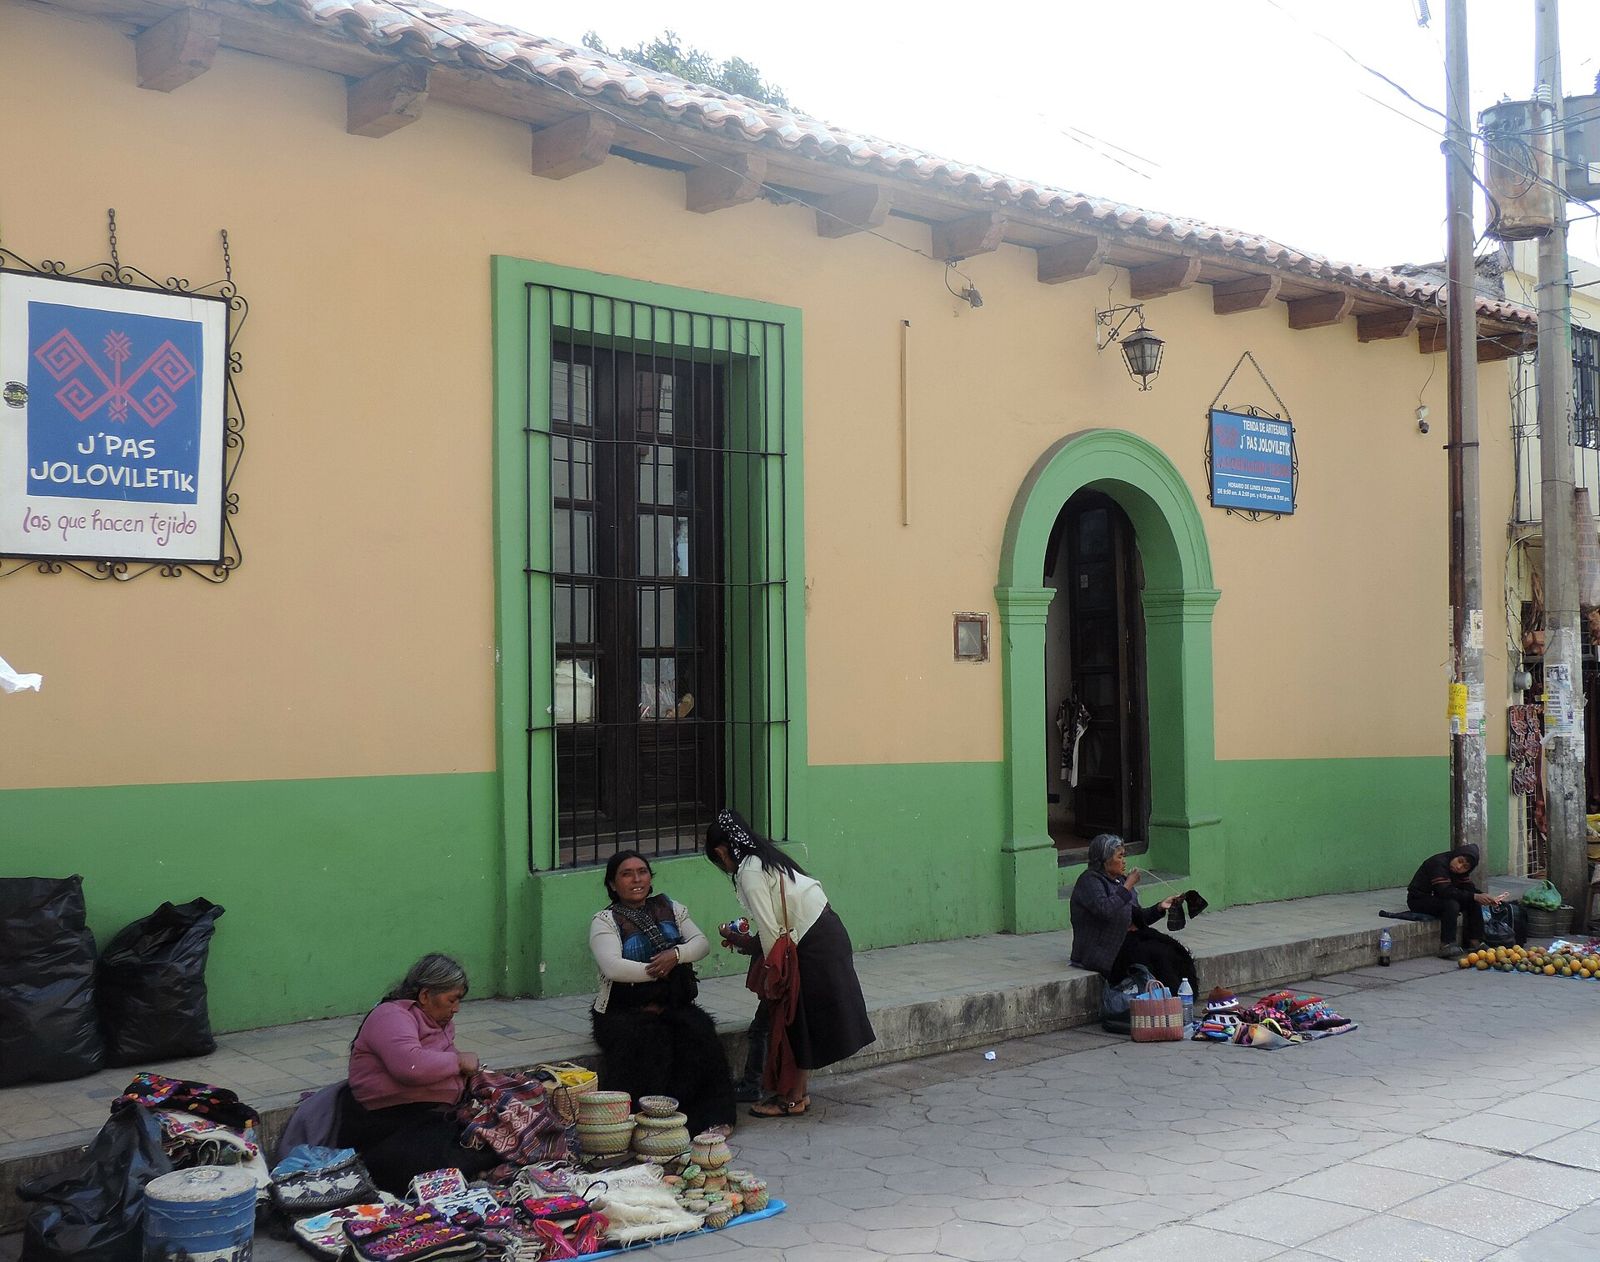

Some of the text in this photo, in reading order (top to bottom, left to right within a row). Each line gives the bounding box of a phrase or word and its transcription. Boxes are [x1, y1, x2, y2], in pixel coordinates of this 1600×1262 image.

[1243, 420, 1259, 432] TIENDA
[1260, 422, 1266, 433] DE
[1247, 436, 1257, 452] PAS
[1258, 438, 1290, 456] JOLOVILETIK
[30, 461, 195, 494] JOLOVILETIK
[1228, 482, 1244, 490] HORARIO
[1264, 486, 1280, 494] DOMINGO
[23, 506, 197, 546] las que hacen tejido
